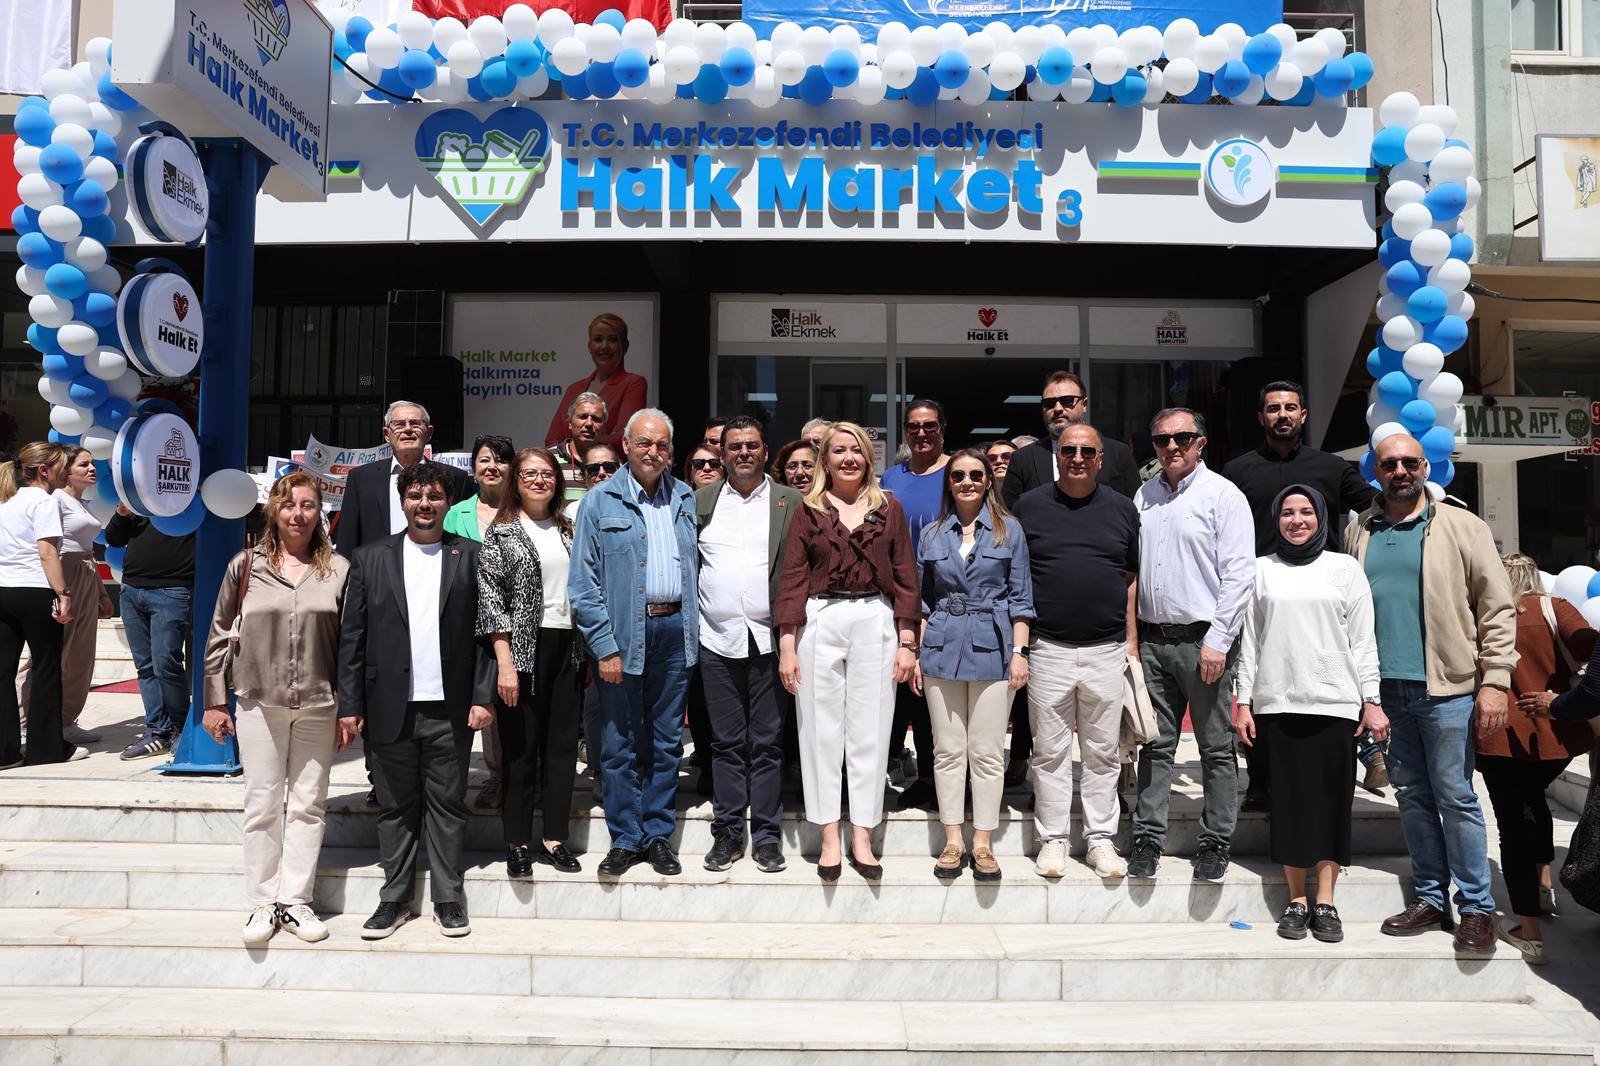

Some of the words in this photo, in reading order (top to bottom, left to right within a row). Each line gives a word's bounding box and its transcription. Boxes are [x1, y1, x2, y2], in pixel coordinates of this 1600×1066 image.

[189, 10, 211, 41] T.C.
[212, 32, 279, 102] Merkezefendi
[279, 92, 321, 139] Belediyesi
[187, 31, 245, 109] Halk
[248, 85, 319, 170] Market
[318, 161, 324, 177] 3
[562, 122, 625, 148] T.C.
[633, 119, 861, 148] Merkezefendi
[870, 120, 1044, 159] Belediyesi
[177, 172, 197, 198] Halk
[560, 154, 742, 212] Halk
[757, 154, 1044, 213] Market
[1056, 188, 1083, 227] 3
[177, 189, 205, 218] Ekmek
[790, 312, 823, 326] Halk
[158, 324, 187, 350] Halk
[187, 336, 199, 354] Et
[791, 325, 837, 338] Ekmek
[967, 331, 996, 341] Halk
[997, 331, 1009, 341] Et
[1157, 330, 1186, 339] HALK
[460, 350, 496, 362] Halk
[500, 350, 558, 362] Market
[463, 366, 541, 379] Halkımıza
[463, 383, 512, 399] Hayırlı
[516, 383, 562, 396] Olsun
[1454, 405, 1526, 438] MIR
[1530, 412, 1562, 434] APT.
[334, 451, 355, 465] Ali
[158, 464, 191, 483] HALK
